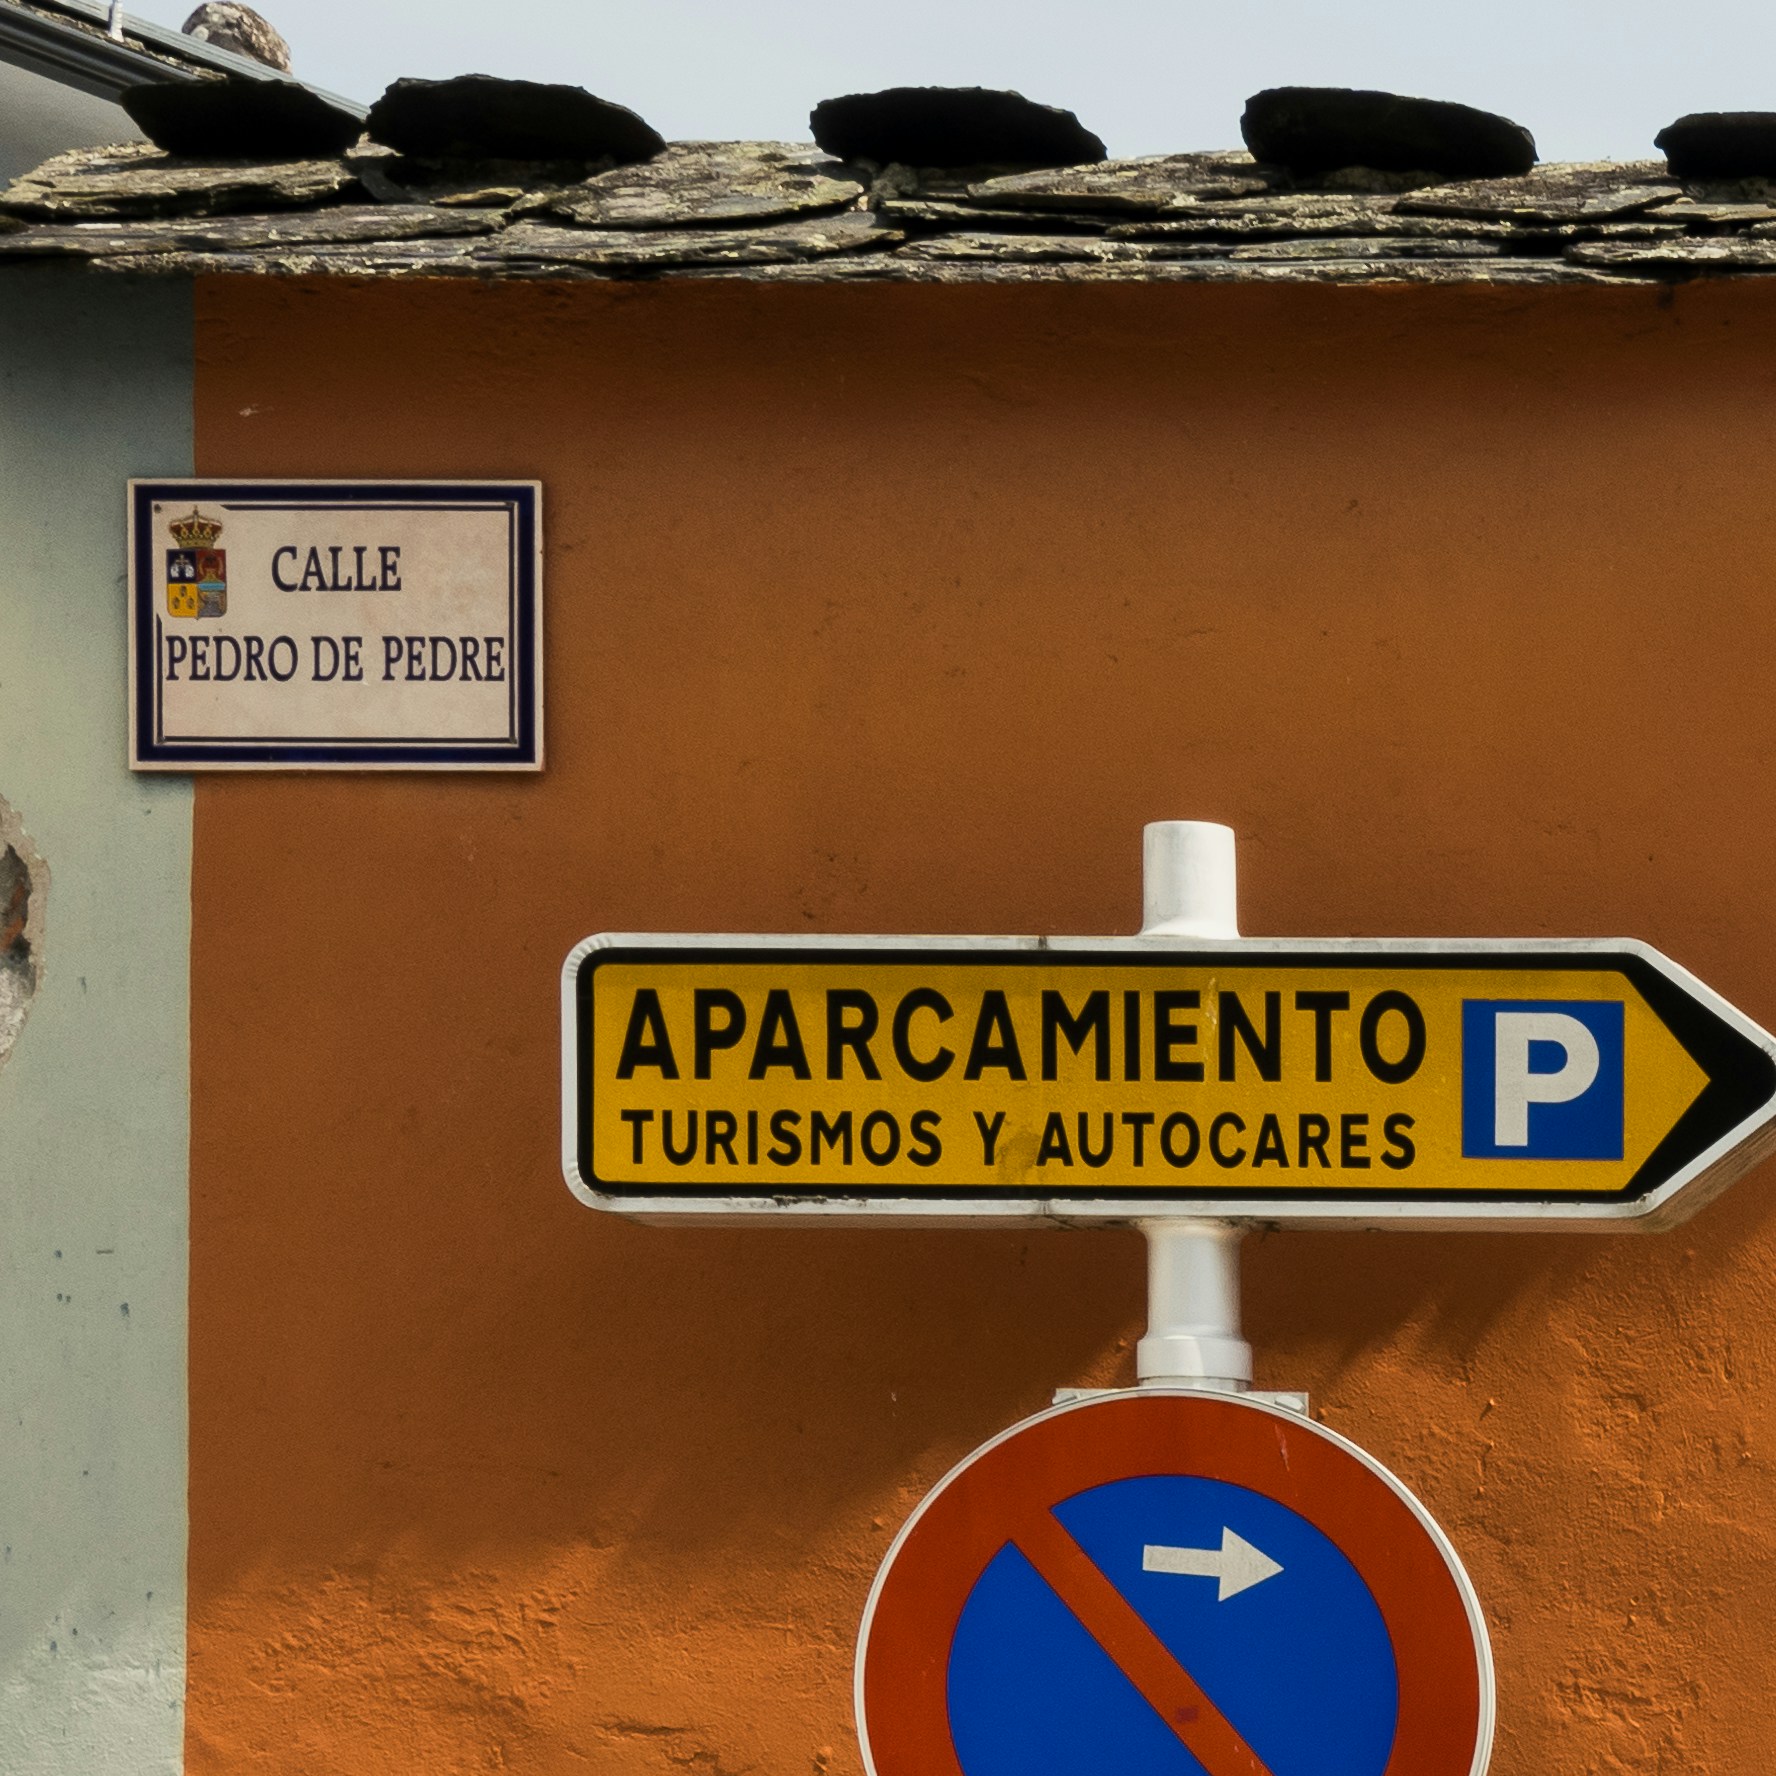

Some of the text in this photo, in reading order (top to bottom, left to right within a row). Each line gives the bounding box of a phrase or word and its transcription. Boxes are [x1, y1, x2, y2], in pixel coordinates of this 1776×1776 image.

[272, 545, 402, 593] CALLE
[165, 635, 505, 682] PEDRO DE PEDRE
[615, 987, 1428, 1085] APARCAMIENTO
[1494, 1012, 1600, 1147] P
[620, 1109, 1417, 1170] TURISMOS Y AUTOCARES
